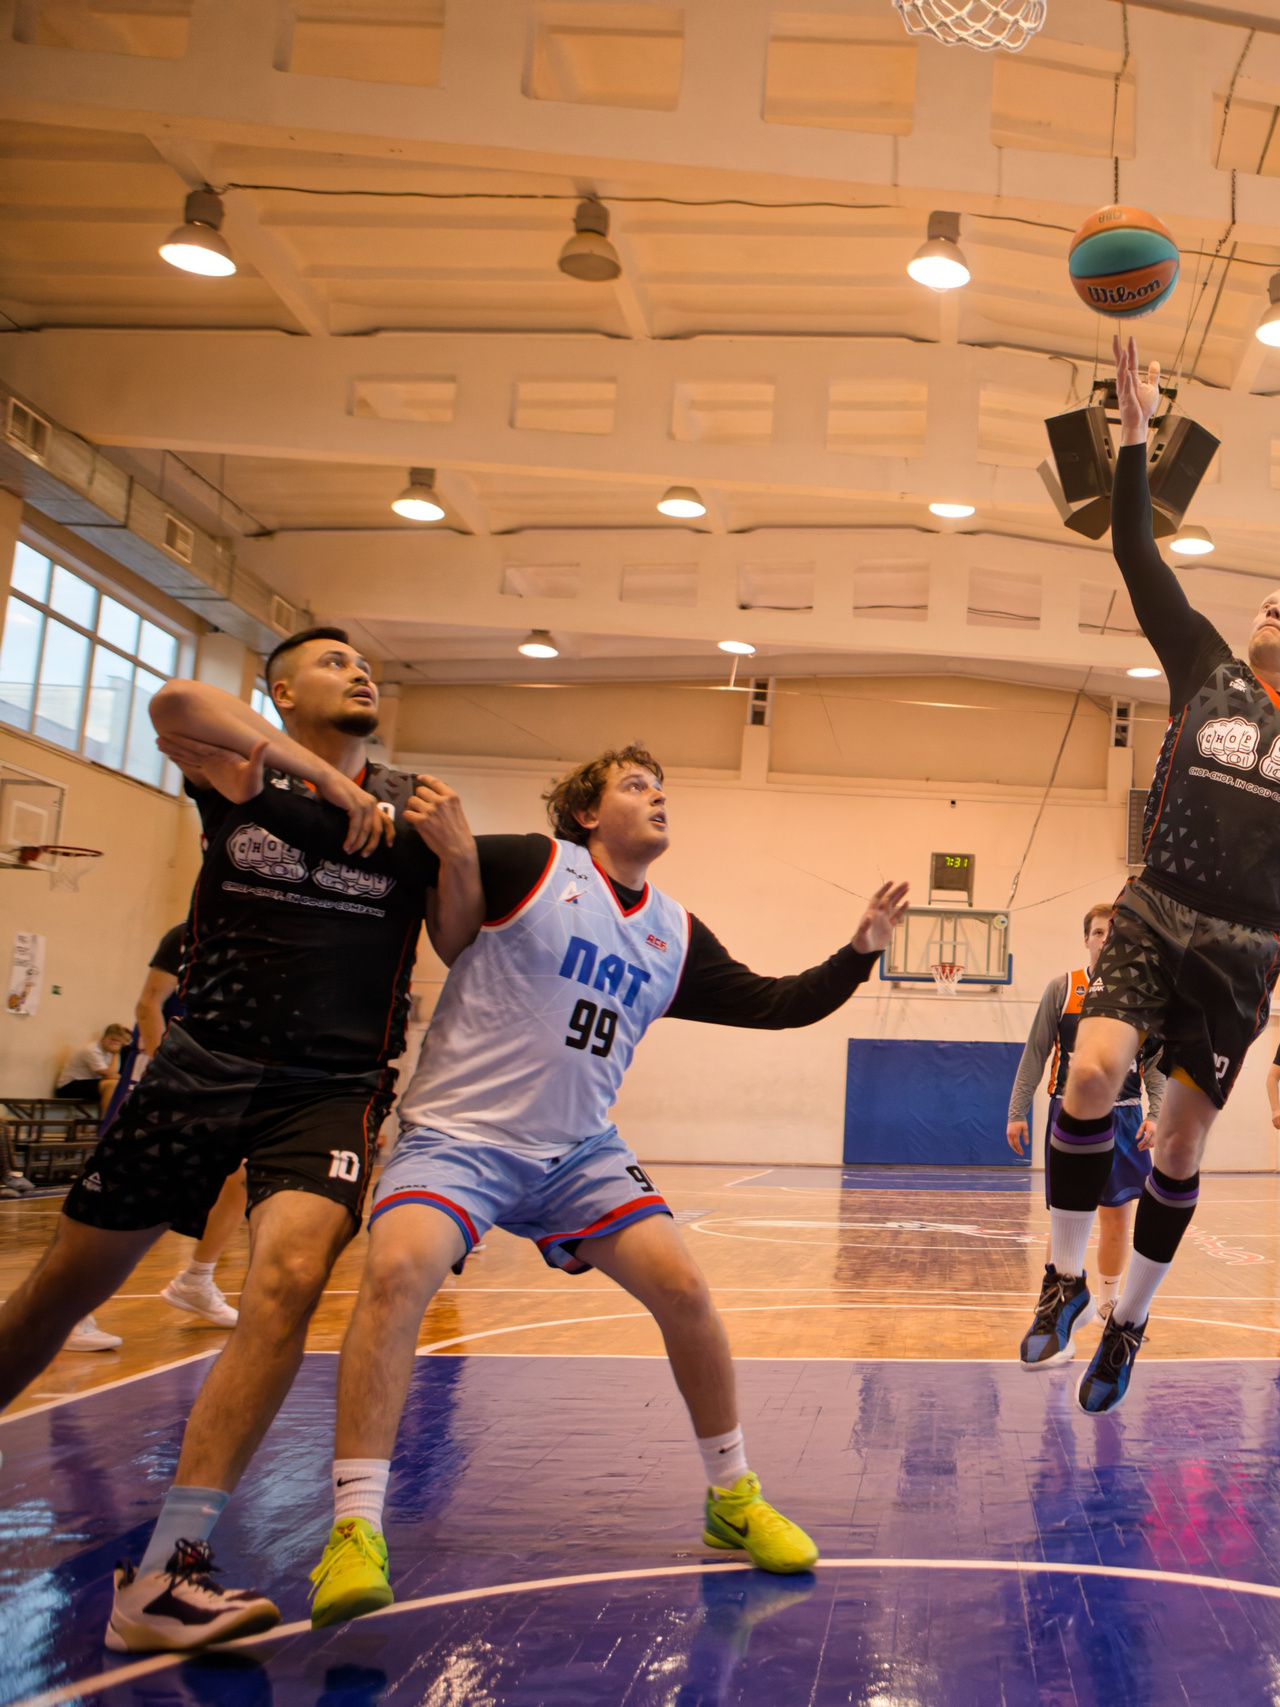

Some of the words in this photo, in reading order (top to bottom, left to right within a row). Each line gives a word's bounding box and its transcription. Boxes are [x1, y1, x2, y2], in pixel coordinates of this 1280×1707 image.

[1086, 279, 1161, 304] Wilson
[1204, 734, 1252, 744] CHOP
[1234, 778, 1246, 790] IN
[1246, 782, 1272, 798] GOOD
[945, 856, 968, 868] 7:31
[565, 998, 618, 1058] 99
[328, 1150, 360, 1182] 10
[625, 1165, 660, 1193] 9
